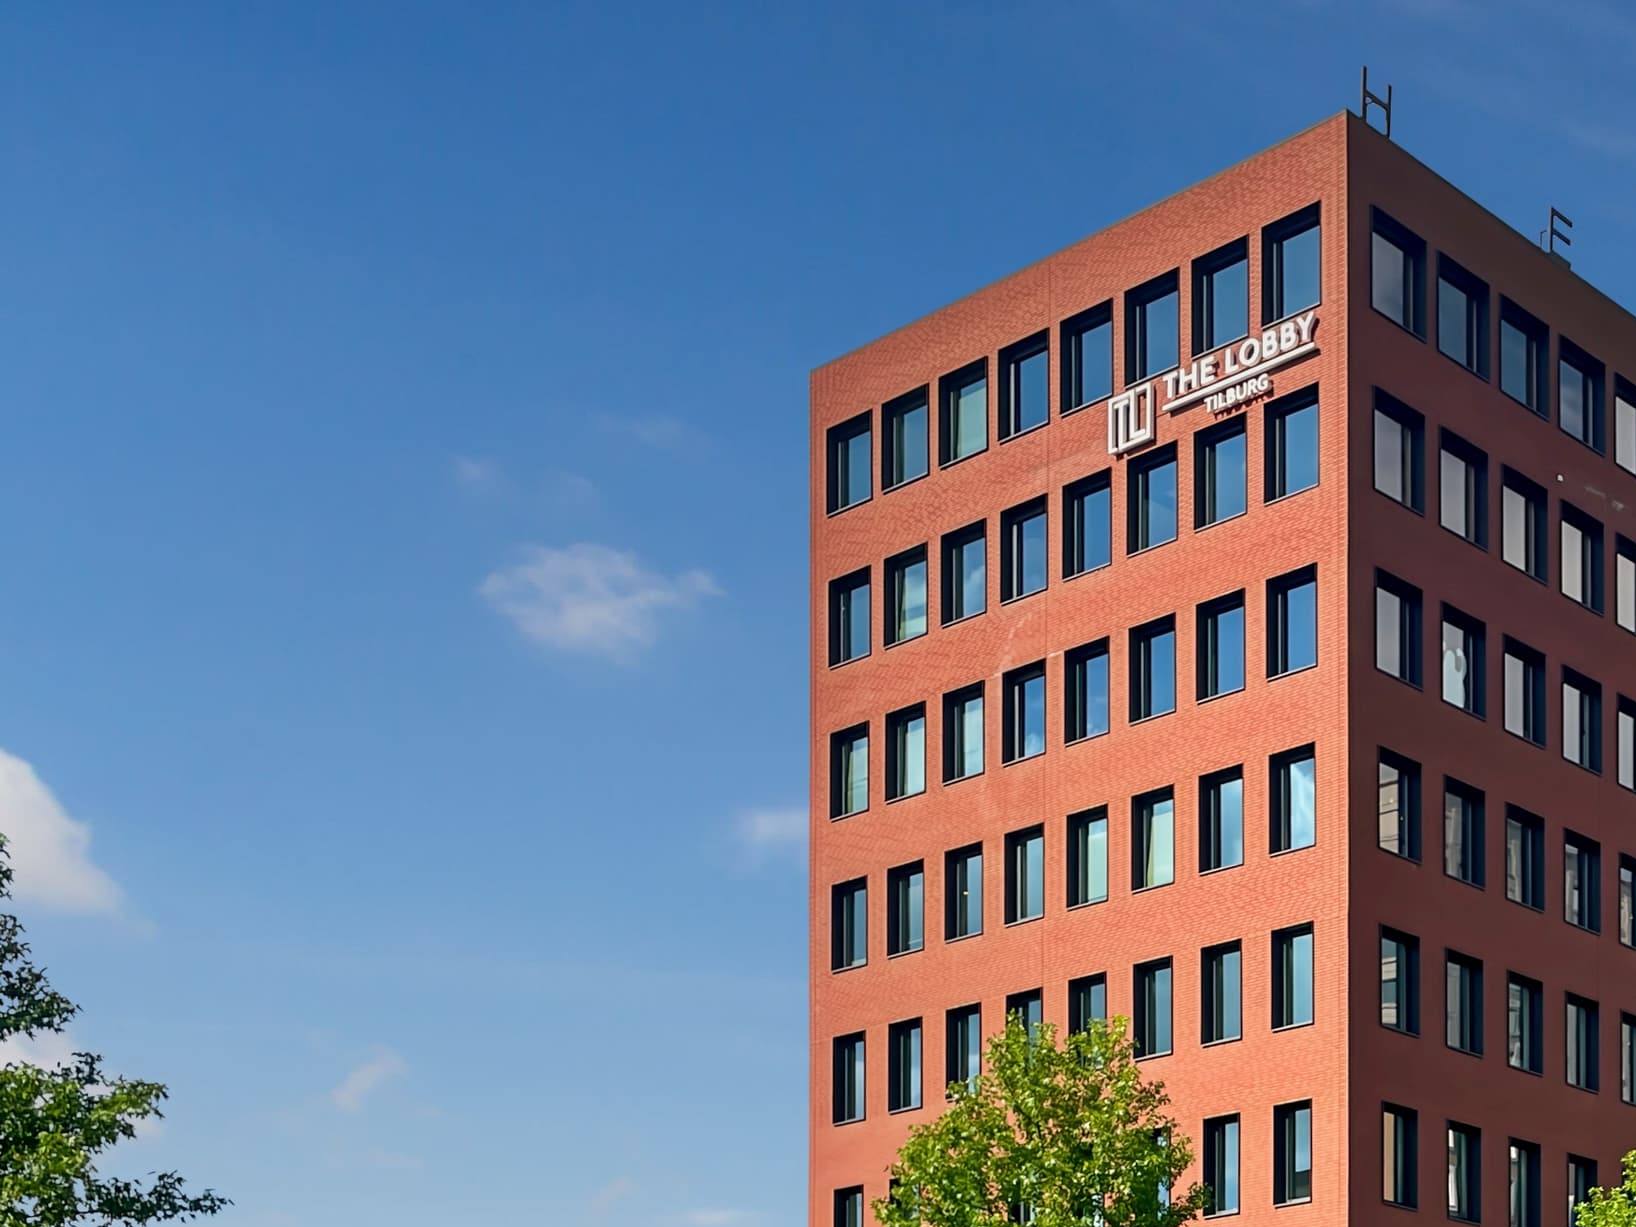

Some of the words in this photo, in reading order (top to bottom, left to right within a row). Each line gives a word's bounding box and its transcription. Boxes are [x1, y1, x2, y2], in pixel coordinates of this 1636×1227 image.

[1162, 355, 1217, 399] THE
[1226, 312, 1316, 372] LOBBY
[1204, 373, 1270, 413] TILBURG
